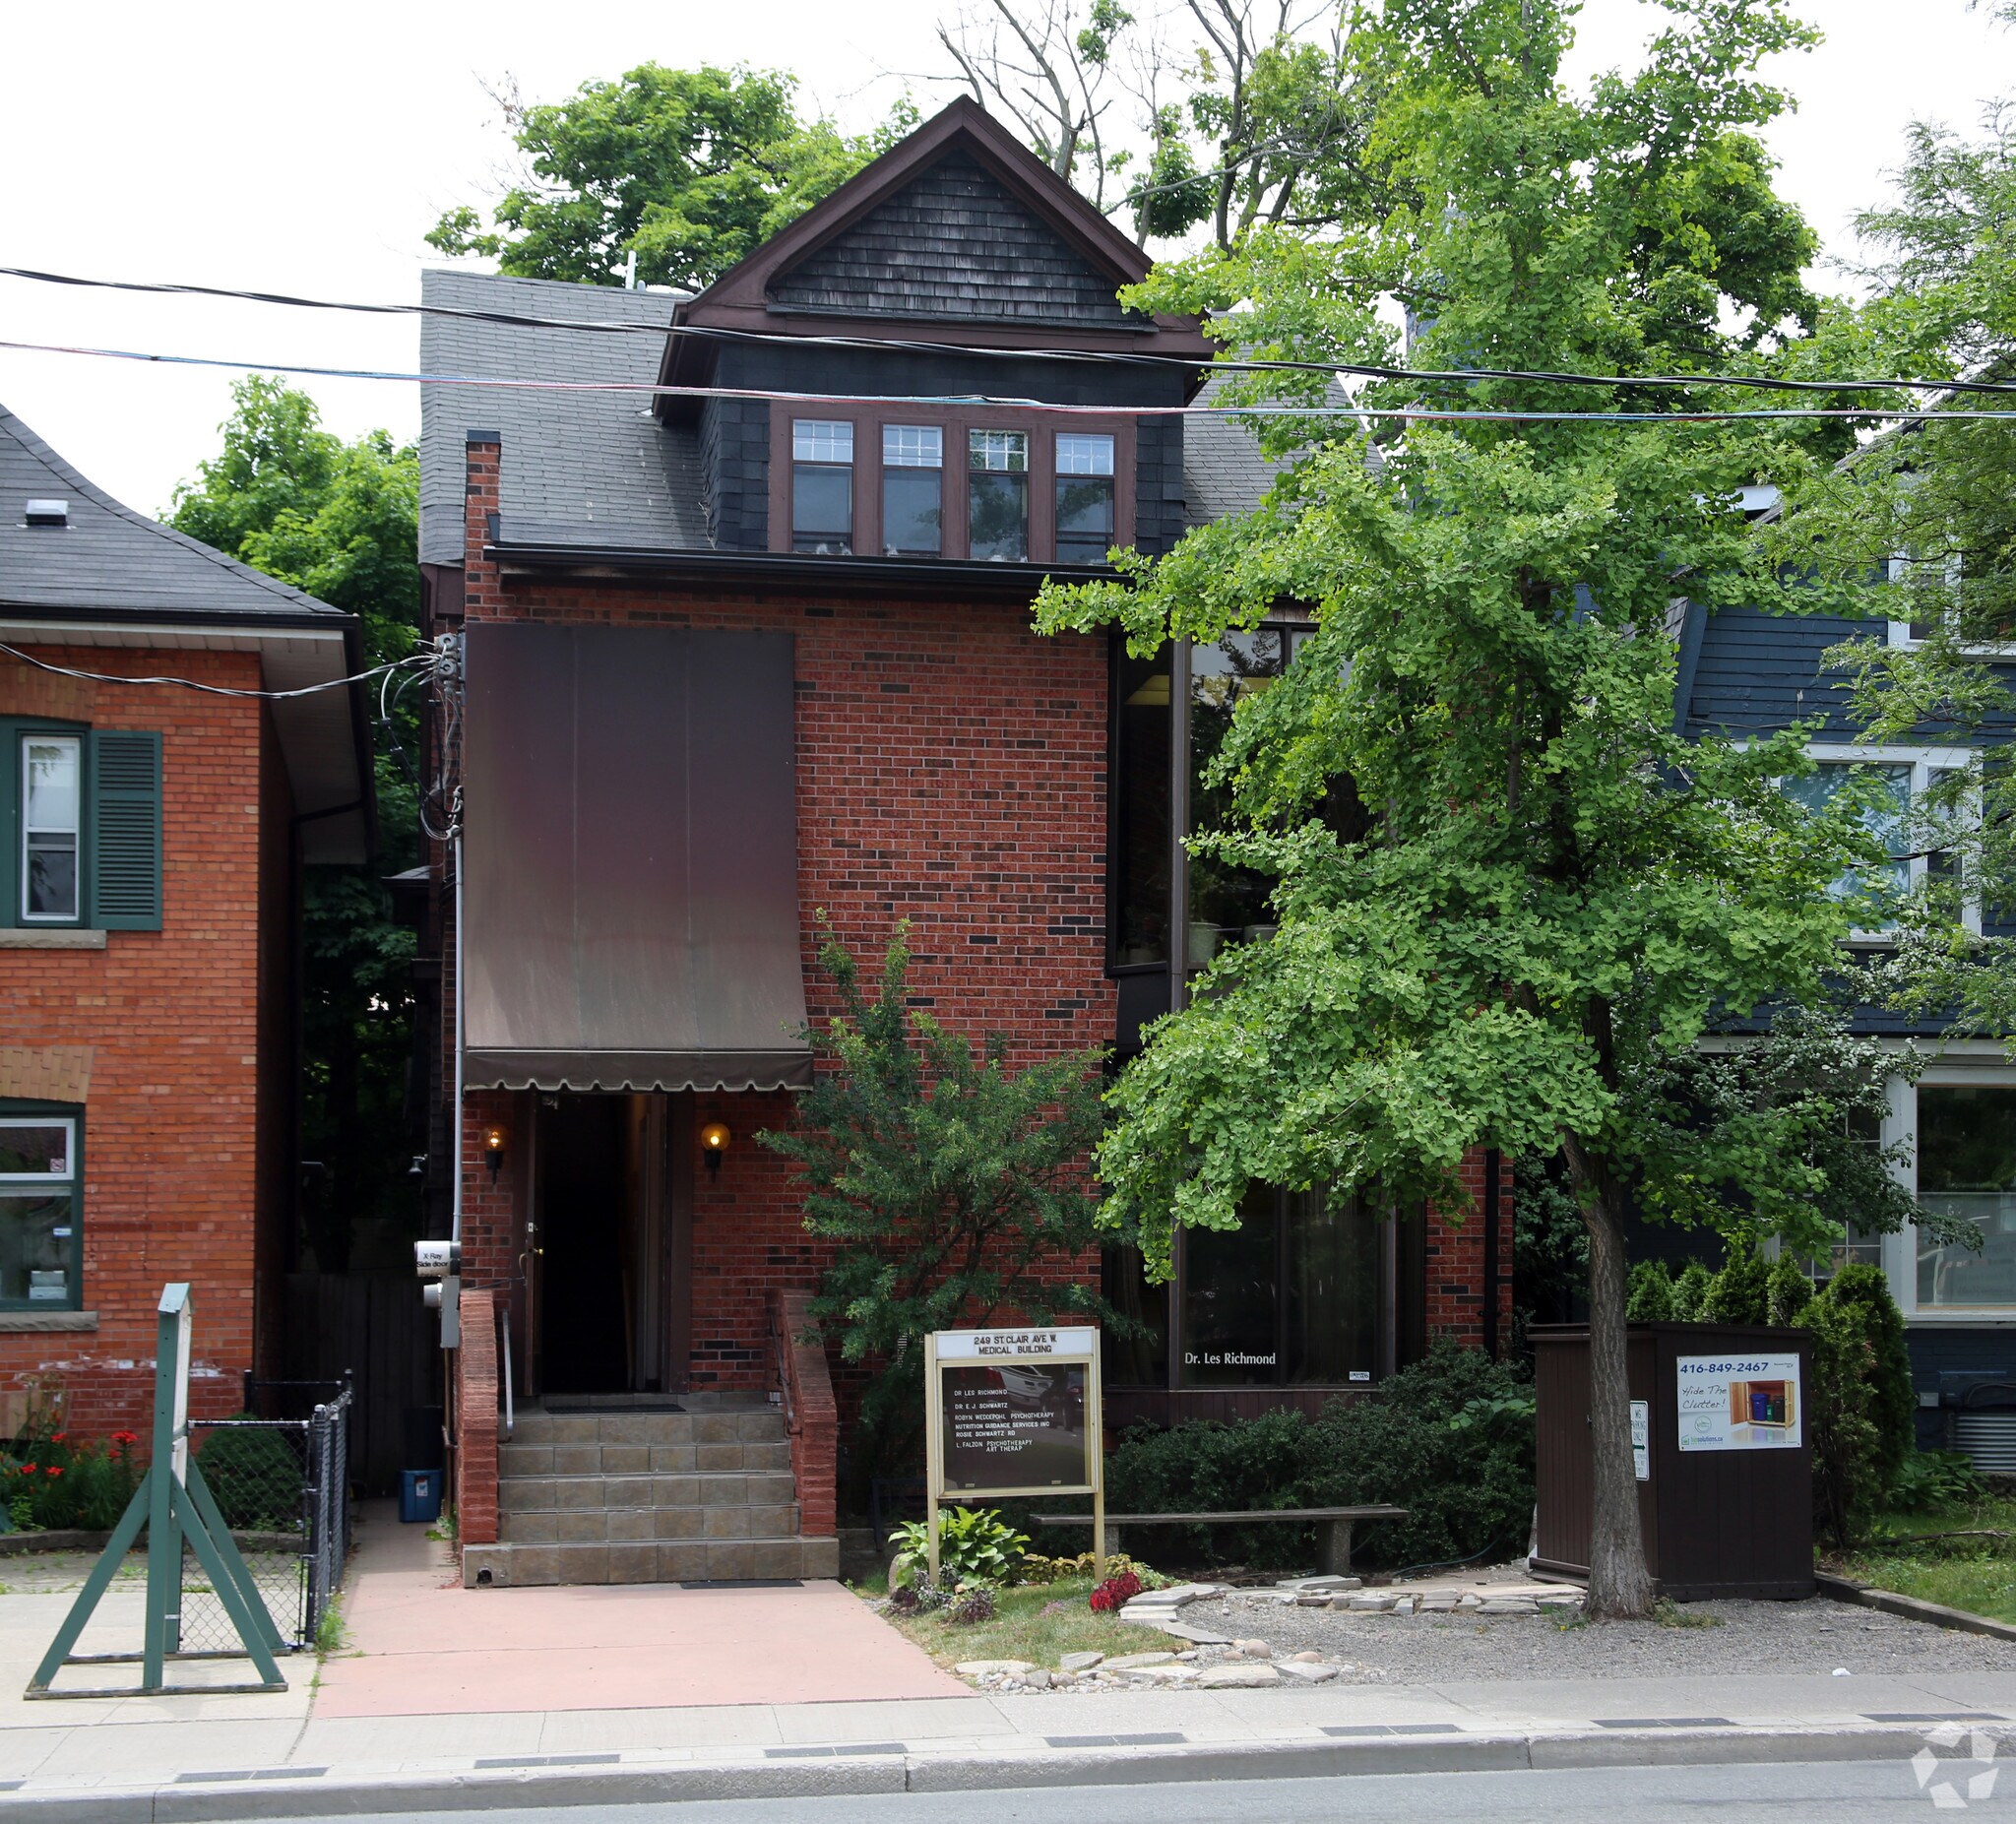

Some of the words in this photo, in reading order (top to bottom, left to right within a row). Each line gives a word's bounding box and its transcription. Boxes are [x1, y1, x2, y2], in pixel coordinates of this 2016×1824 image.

[1006, 1335, 1029, 1344] CLAIR
[1033, 1334, 1046, 1343] AVE
[978, 1346, 1011, 1354] MEDICAL
[1017, 1345, 1052, 1353] BUILDING
[1184, 1352, 1200, 1364] Dr.
[1204, 1352, 1221, 1364] Les
[1224, 1352, 1276, 1364] Richmond
[1680, 1361, 1769, 1374] 416-849-2467
[1682, 1385, 1704, 1396] Hide
[1708, 1384, 1728, 1395] The
[1682, 1399, 1726, 1410] Clutter!
